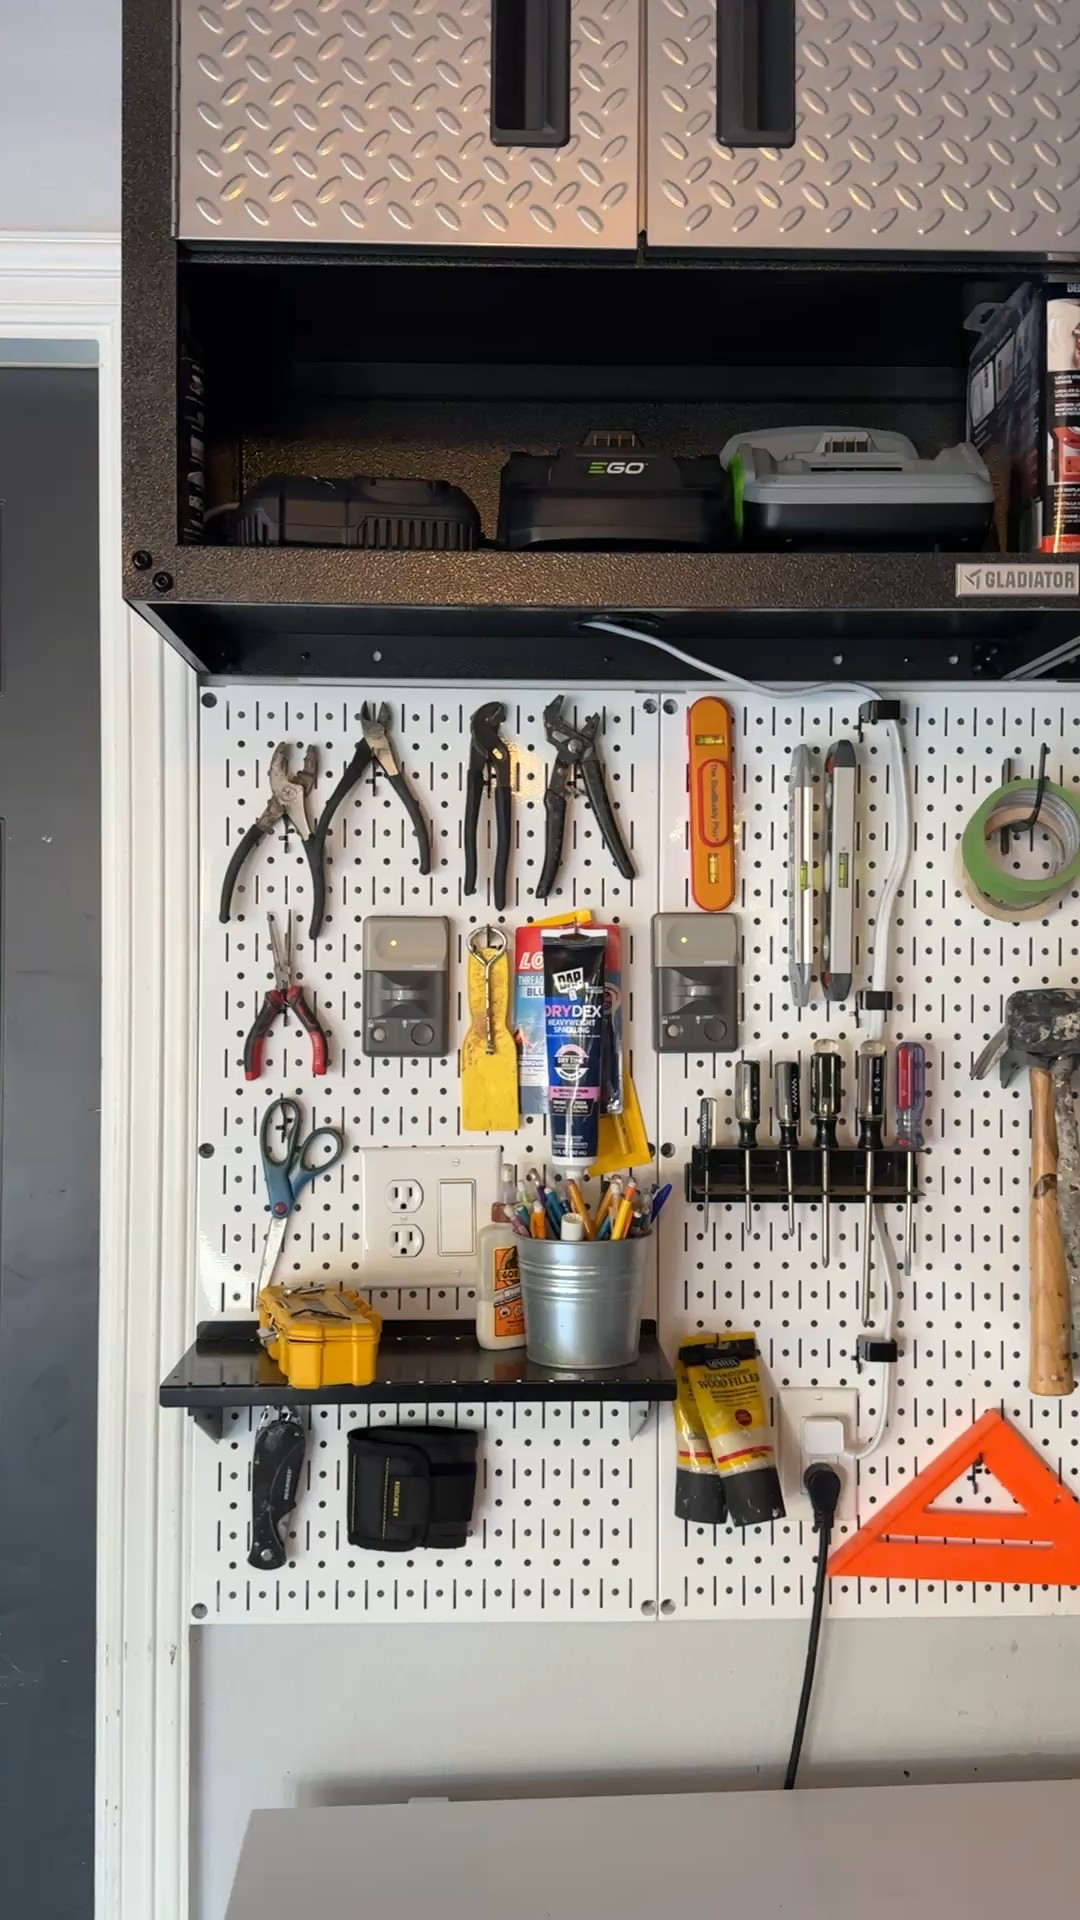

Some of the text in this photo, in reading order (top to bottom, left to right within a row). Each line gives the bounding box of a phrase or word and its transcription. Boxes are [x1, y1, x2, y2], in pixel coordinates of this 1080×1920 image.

[588, 461, 645, 475] EGO
[984, 571, 1075, 589] GLADIATOR
[557, 971, 581, 985] DAP
[544, 1005, 601, 1018] DRYDEX
[547, 1019, 596, 1027] HEAVYWEIGHT
[553, 1026, 590, 1034] SPACKLING
